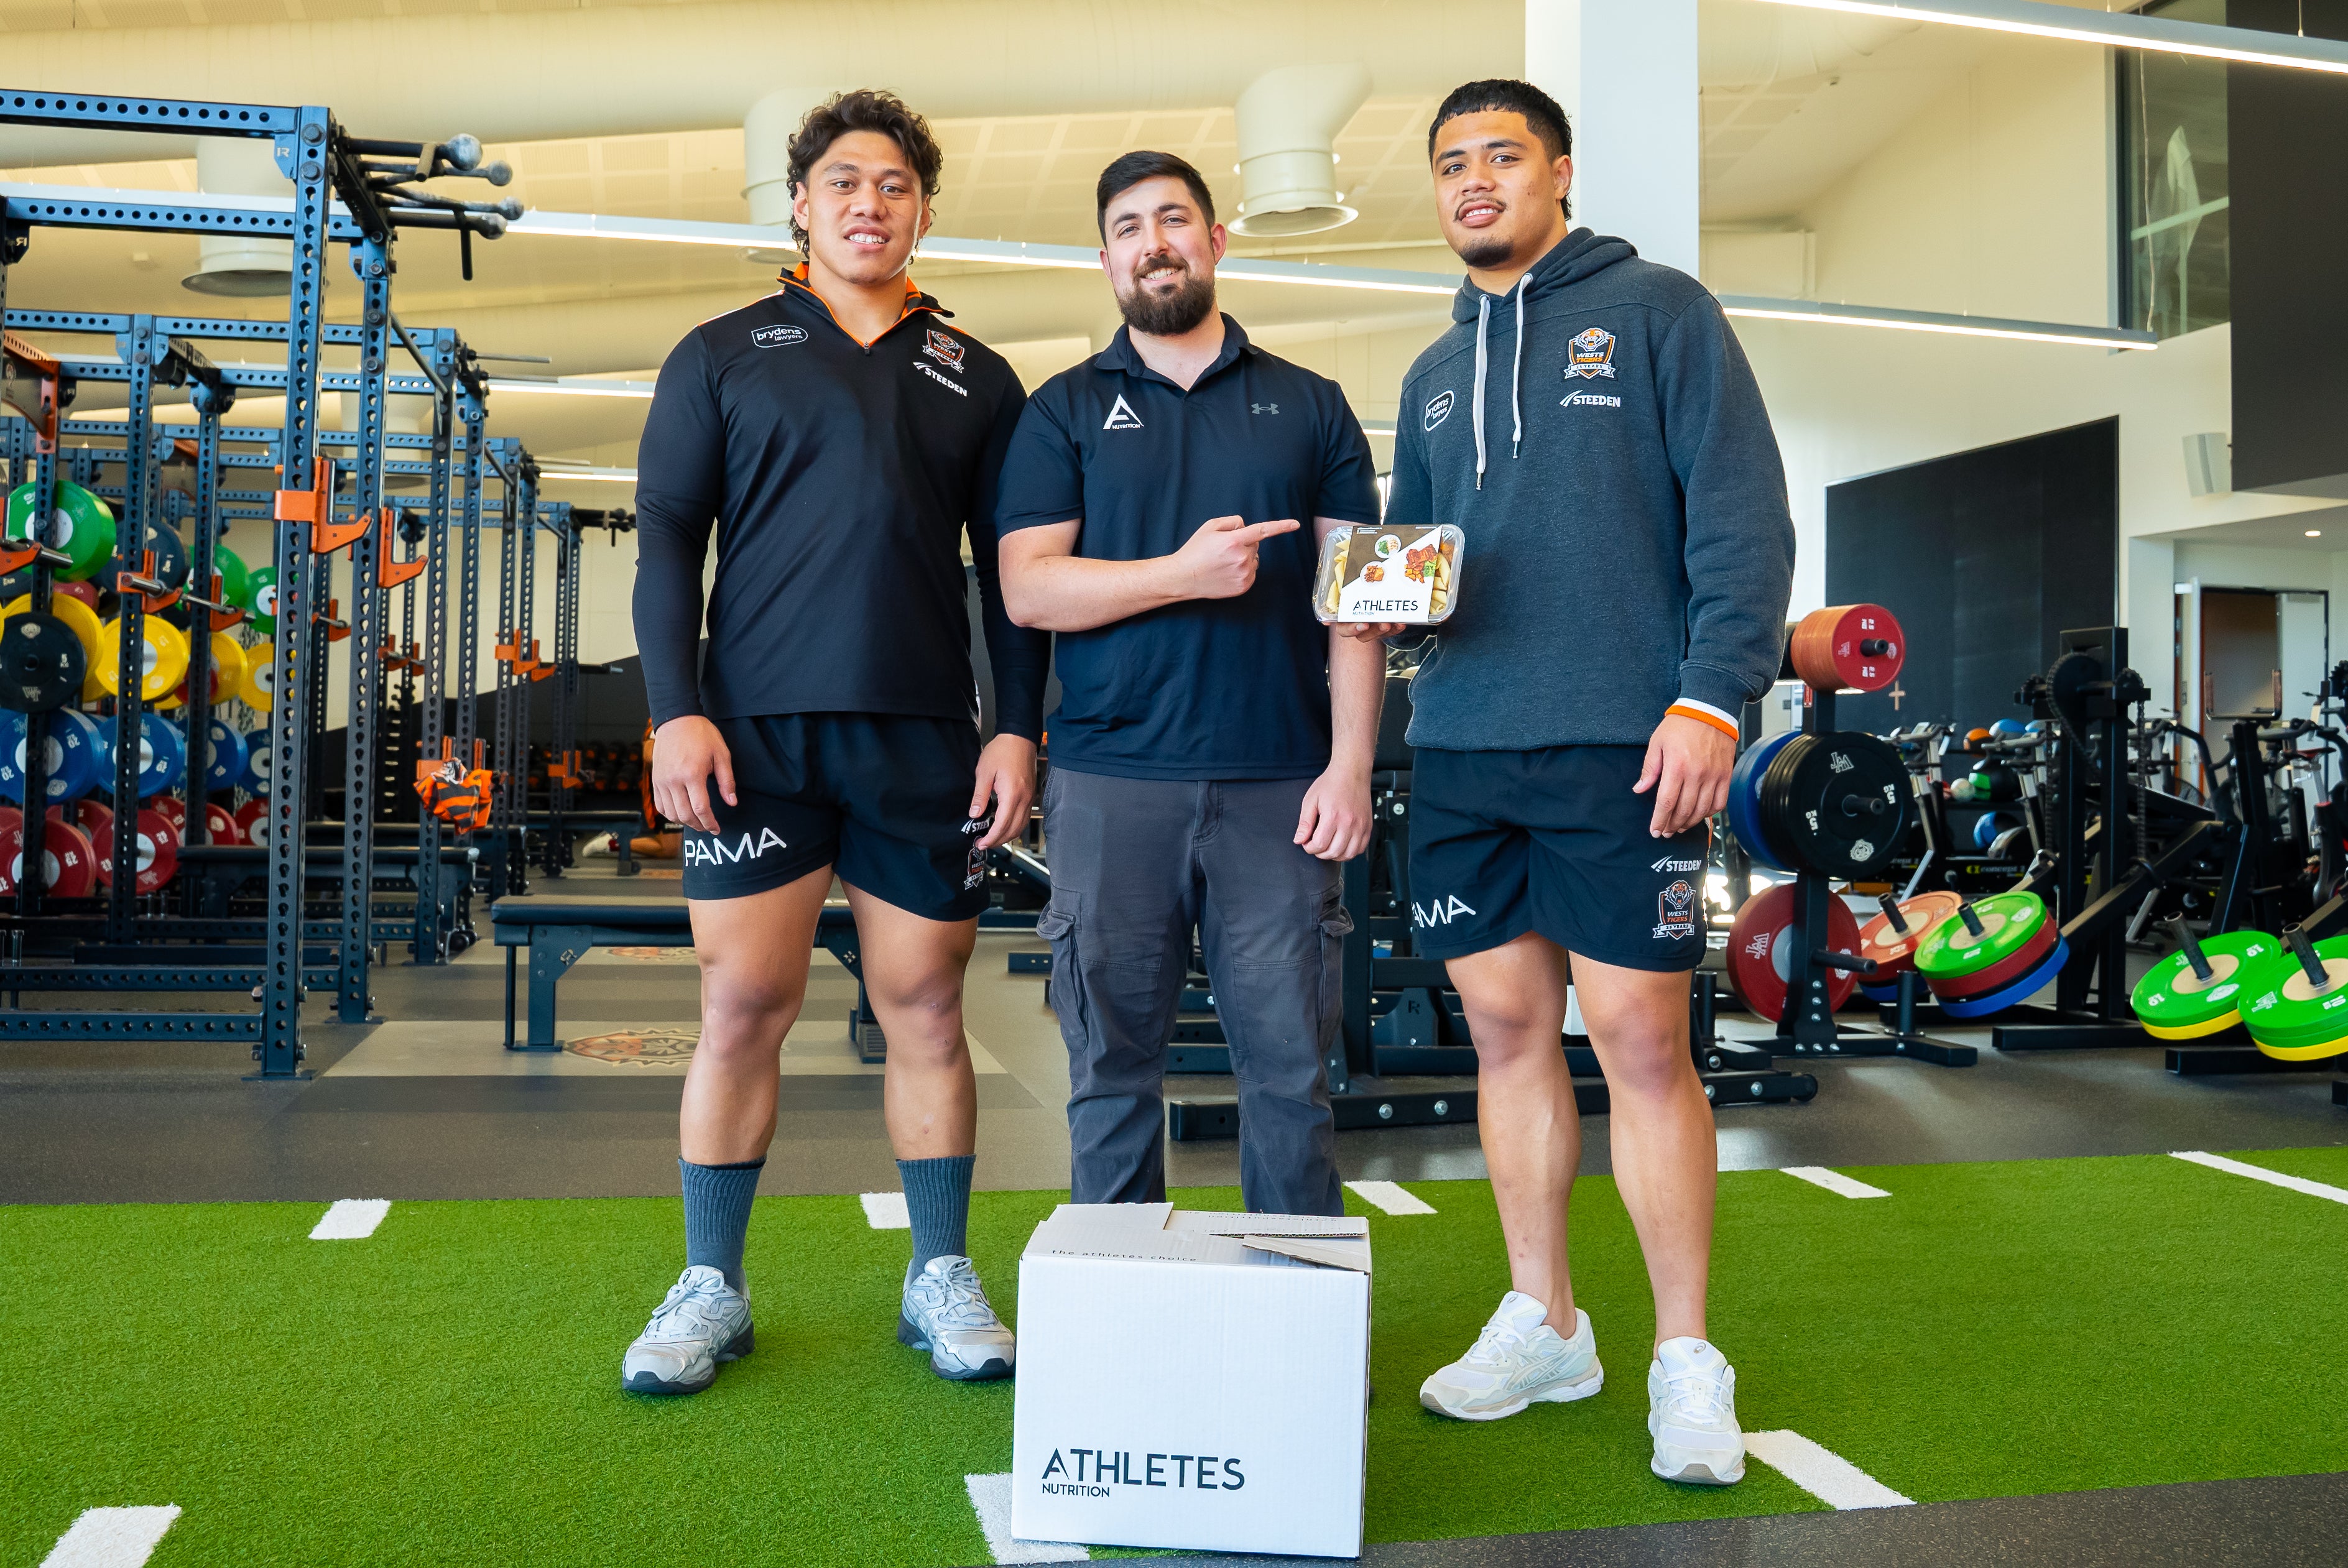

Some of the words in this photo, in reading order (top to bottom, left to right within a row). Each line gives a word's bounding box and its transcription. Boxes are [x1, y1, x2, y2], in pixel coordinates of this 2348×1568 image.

[756, 328, 801, 340] brydens
[925, 367, 968, 397] STEEDEN
[1573, 395, 1621, 407] STEEDEN
[1353, 600, 1418, 611] ATHLETES
[1887, 791, 1896, 805] 5
[1810, 818, 1818, 830] 5
[685, 827, 787, 867] PAMA
[1666, 860, 1702, 872] STEEDEN
[1411, 895, 1476, 928] AMA
[1042, 1448, 1245, 1490] ATHLETES
[1042, 1483, 1110, 1498] NUTRITION
